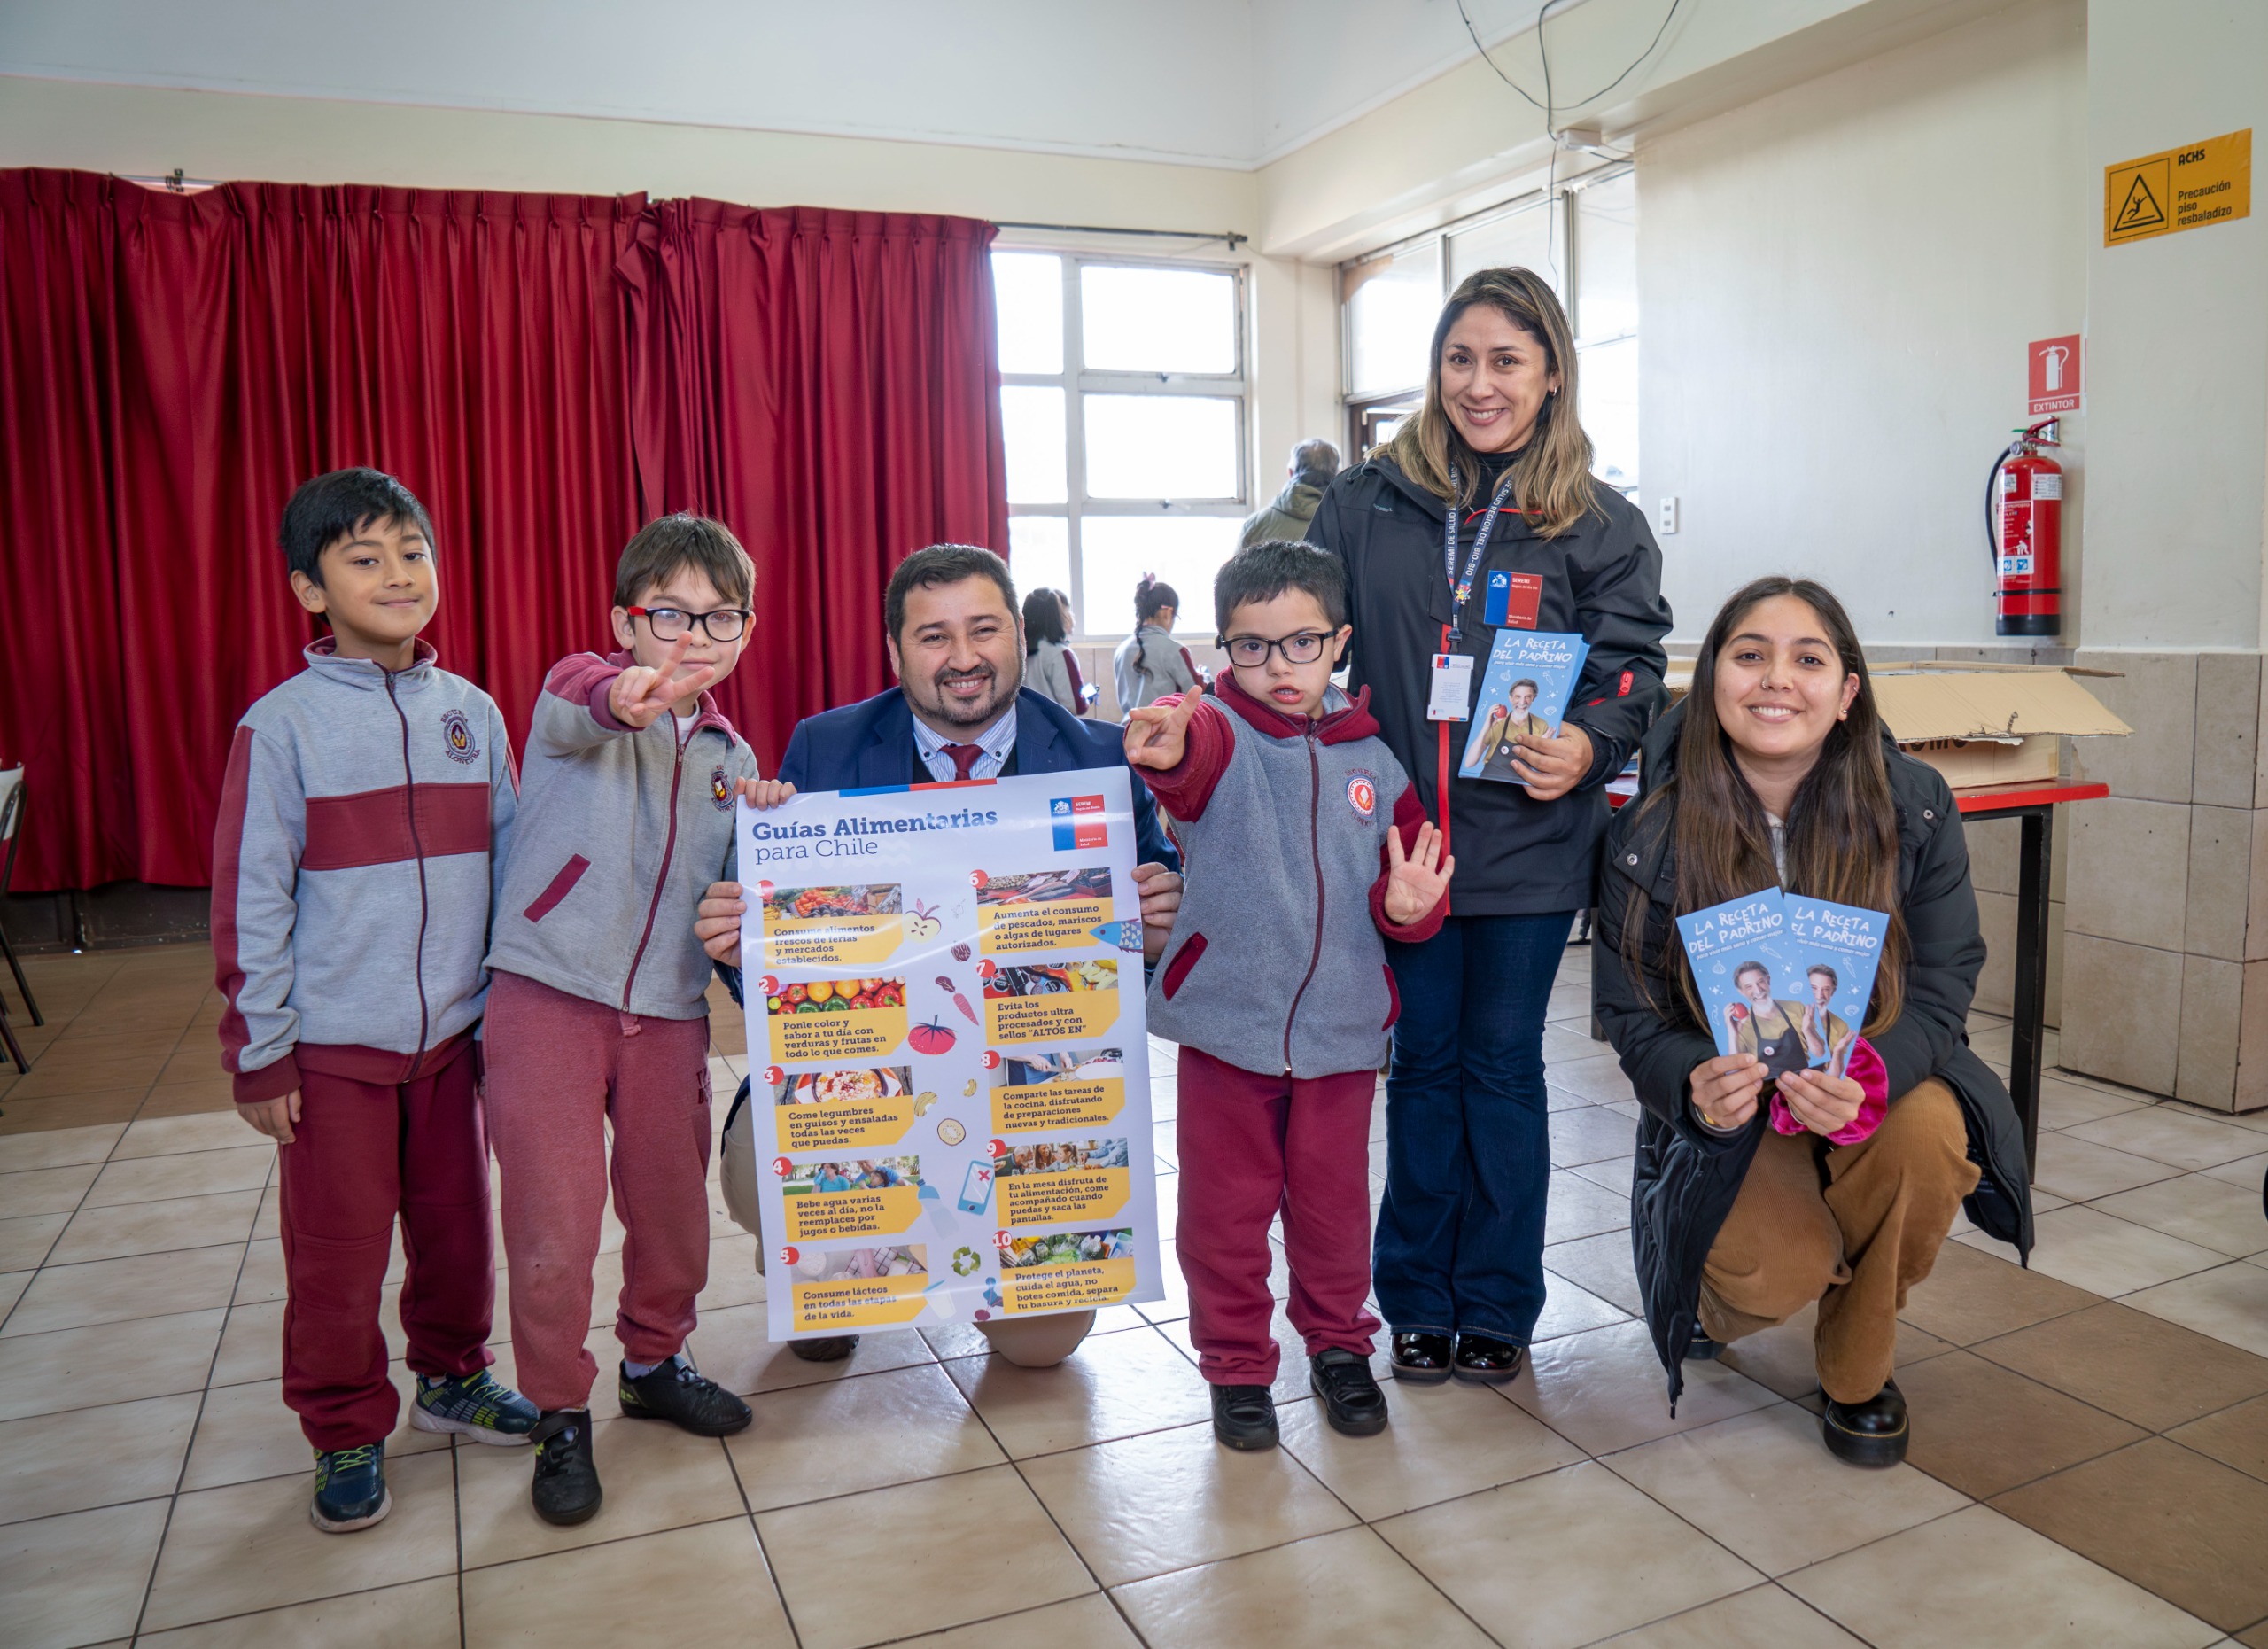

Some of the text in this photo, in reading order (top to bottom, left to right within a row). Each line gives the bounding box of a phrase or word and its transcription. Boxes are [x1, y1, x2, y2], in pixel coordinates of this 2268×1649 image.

[2178, 148, 2206, 166] ACHS
[2178, 180, 2231, 201] Precaución
[2178, 200, 2197, 216] piso
[2177, 206, 2232, 226] resbaladizo
[2033, 399, 2075, 413] EXTINTOR
[1465, 488, 1509, 576] SALUD REGION DEL BIO-BIO
[1504, 638, 1565, 650] LA RECETA
[1493, 649, 1573, 663] DEL PADRINO
[752, 808, 998, 840] Guías Alimentarias
[756, 838, 878, 865] para Chile
[969, 873, 978, 886] 6
[994, 909, 1039, 919] Aumenta
[1052, 906, 1099, 915] consumo
[1795, 906, 1869, 932] LA RECETA
[1008, 914, 1102, 930] pescados, mariscos
[1695, 903, 1769, 937] LA RECETA
[774, 924, 875, 937] Consume alimentos
[1003, 931, 1029, 941] algas
[1031, 929, 1043, 937] de
[1045, 927, 1082, 937] lugares
[1689, 913, 1783, 954] DEL PADRINO
[1813, 925, 1877, 949] PADRINO
[775, 945, 834, 956] y mercados
[996, 939, 1057, 950] autorizados.
[776, 954, 842, 965] establecidos.
[976, 962, 986, 976] 7
[759, 978, 769, 992] 2
[998, 1002, 1023, 1011] Evita
[998, 1007, 1074, 1022] productos ultra
[783, 1020, 841, 1031] Ponle color
[998, 1021, 1054, 1031] procesados
[784, 1031, 812, 1040] sabor
[998, 1031, 1027, 1039] sellos
[785, 1039, 830, 1049] verduras
[841, 1036, 872, 1046] frutas
[785, 1049, 809, 1058] todo
[823, 1048, 842, 1057] que
[843, 1046, 879, 1054] comes.
[981, 1054, 991, 1066] 8
[764, 1070, 774, 1083] 3
[1003, 1091, 1048, 1101] Comparte
[1014, 1099, 1047, 1108] cocina,
[1049, 1095, 1103, 1106] disfrutando
[788, 1108, 874, 1120] Come legumbres
[1016, 1108, 1081, 1119] preparaciones
[804, 1118, 838, 1129] guisos
[849, 1114, 898, 1124] ensaladas
[1005, 1114, 1109, 1129] nuevas tradicionales.
[790, 1129, 819, 1138] todas
[791, 1137, 851, 1148] que puedas.
[773, 1160, 783, 1173] 4
[1058, 1178, 1094, 1186] disfruta
[1021, 1186, 1083, 1198] alimentación,
[796, 1195, 881, 1209] Bebe agua varias
[1009, 1193, 1103, 1207] acompañado cuando
[839, 1206, 858, 1215] día,
[1010, 1205, 1043, 1216] puedas
[798, 1214, 875, 1226] reemplaces por
[1011, 1214, 1054, 1225] pantallas.
[799, 1224, 880, 1238] jugos bebidas.
[993, 1233, 1011, 1247] 10
[780, 1249, 790, 1263] 5
[1015, 1272, 1053, 1281] Protege
[1066, 1266, 1105, 1277] planeta,
[1015, 1282, 1044, 1292] cuida
[1056, 1280, 1083, 1288] agua,
[804, 1286, 888, 1300] Consume lácteos
[1016, 1286, 1119, 1302] botes comida, separa
[819, 1299, 845, 1309] todas
[864, 1295, 897, 1306] etapas
[1030, 1300, 1063, 1309] basura
[804, 1312, 817, 1321] de
[830, 1310, 855, 1318] vida.
